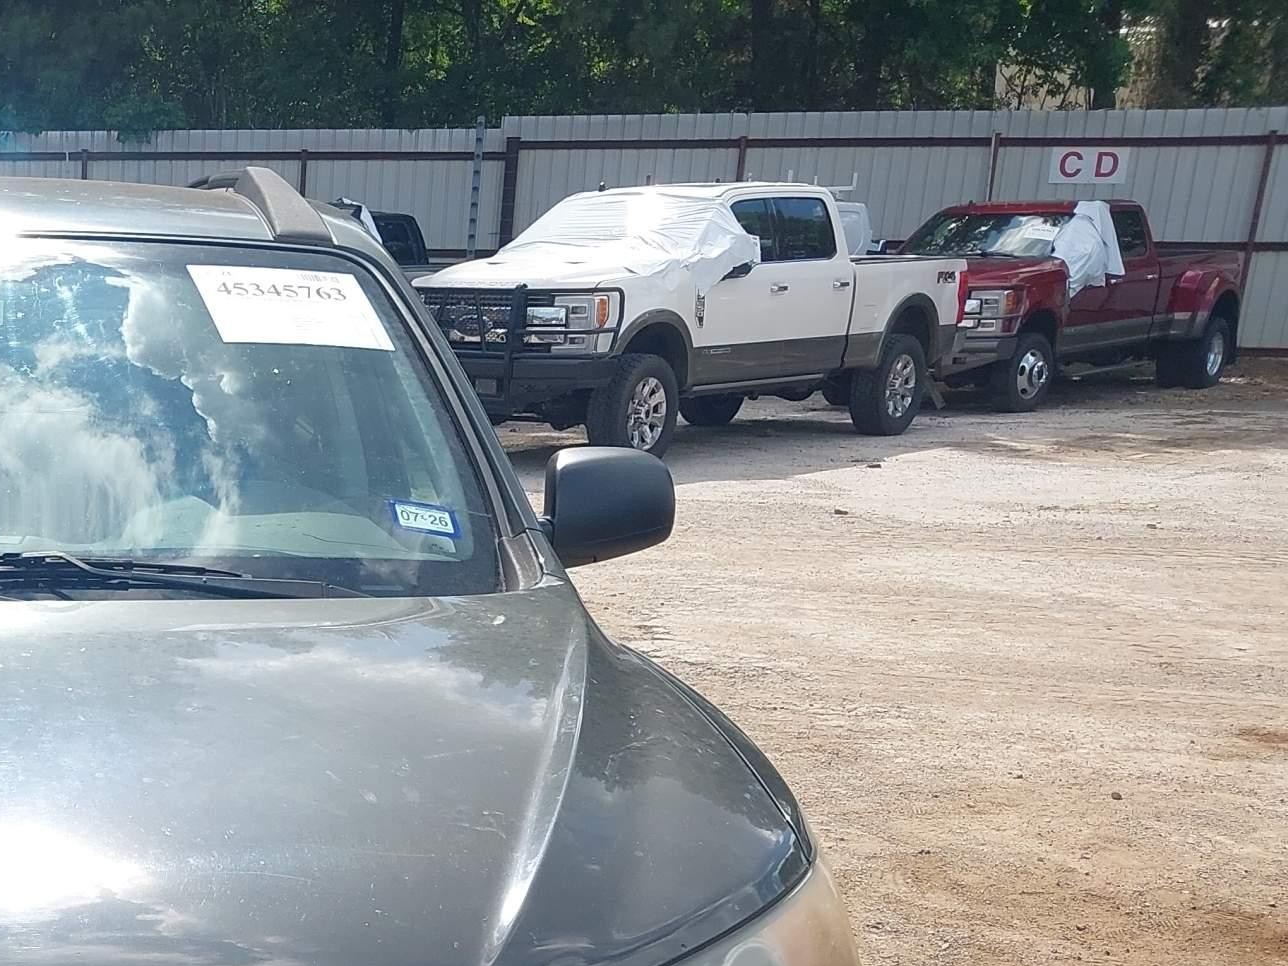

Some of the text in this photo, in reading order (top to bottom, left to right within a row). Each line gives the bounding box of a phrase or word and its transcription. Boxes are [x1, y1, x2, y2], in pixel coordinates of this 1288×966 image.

[1059, 151, 1119, 178] C D
[216, 281, 347, 301] 45345763
[400, 509, 449, 528] 07 26
